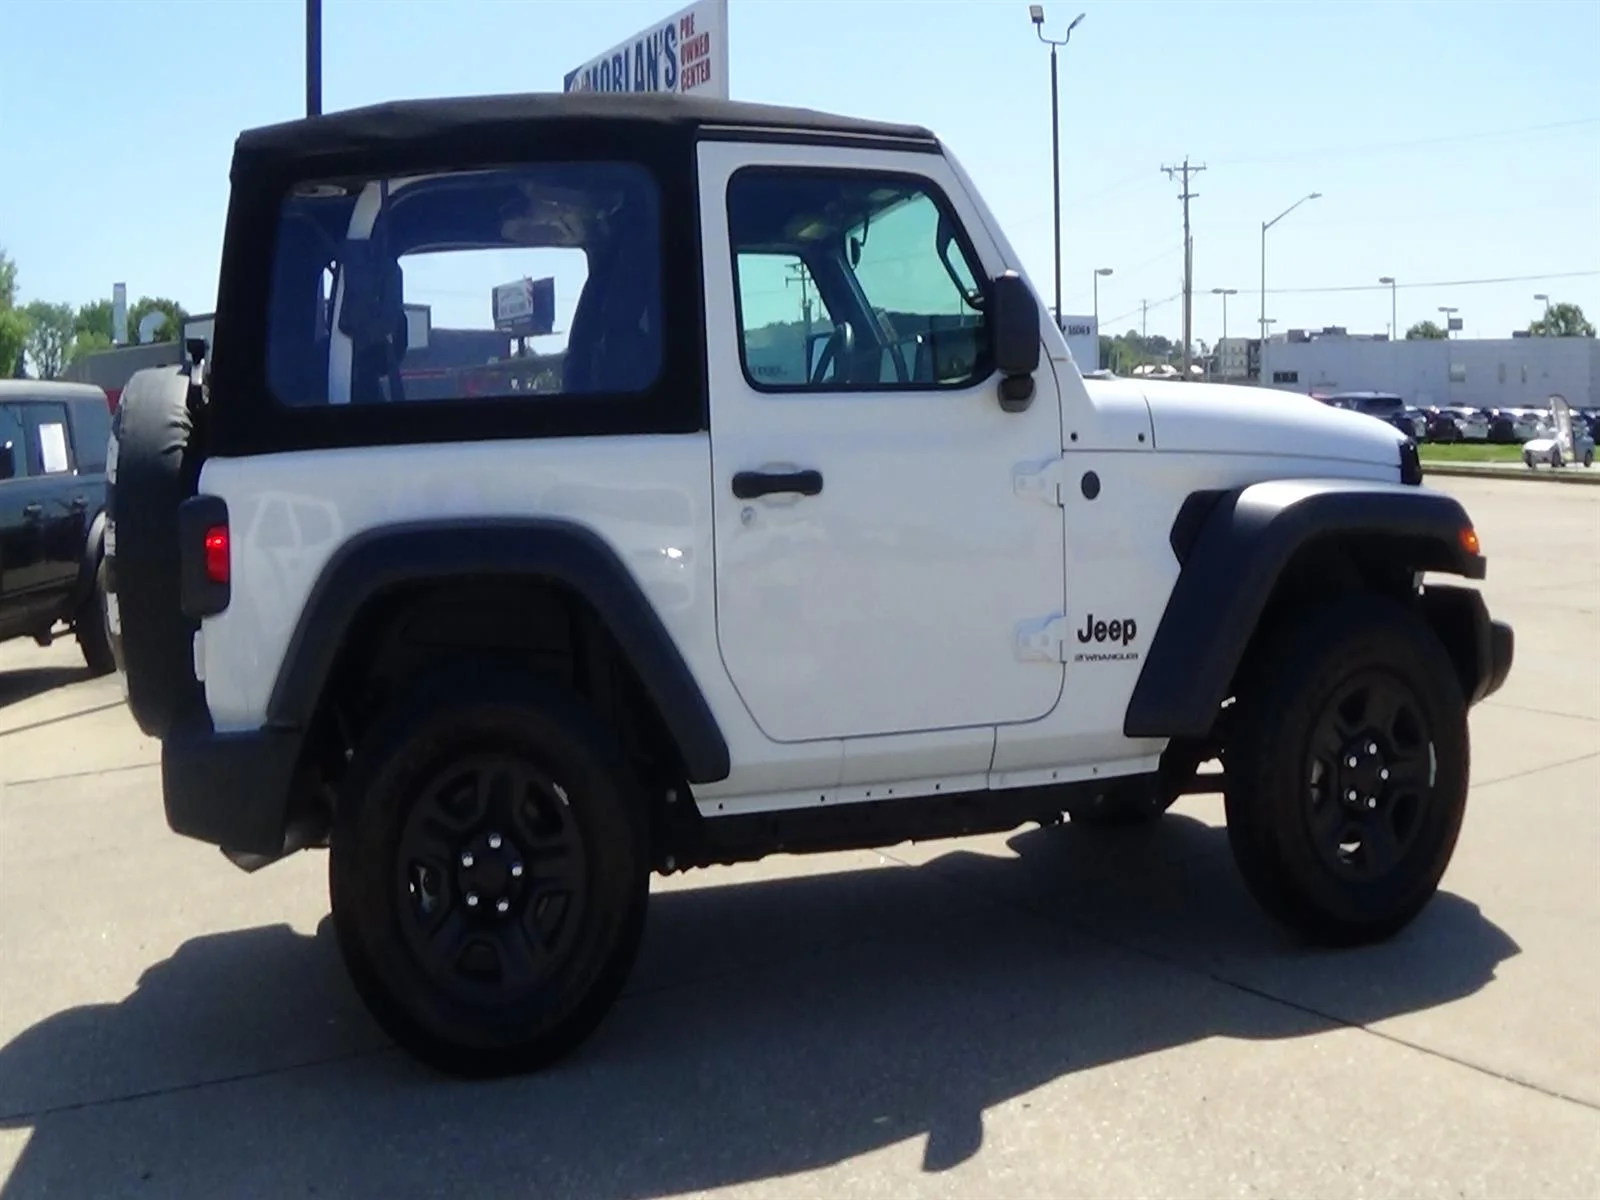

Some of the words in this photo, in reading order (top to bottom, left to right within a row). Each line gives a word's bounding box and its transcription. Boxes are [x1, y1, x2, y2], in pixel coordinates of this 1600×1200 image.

[680, 12, 695, 40] PRE
[680, 31, 710, 66] OWNED
[680, 58, 711, 93] CENTER
[1077, 613, 1137, 646] Jeep
[1084, 652, 1139, 661] WRANGLER
